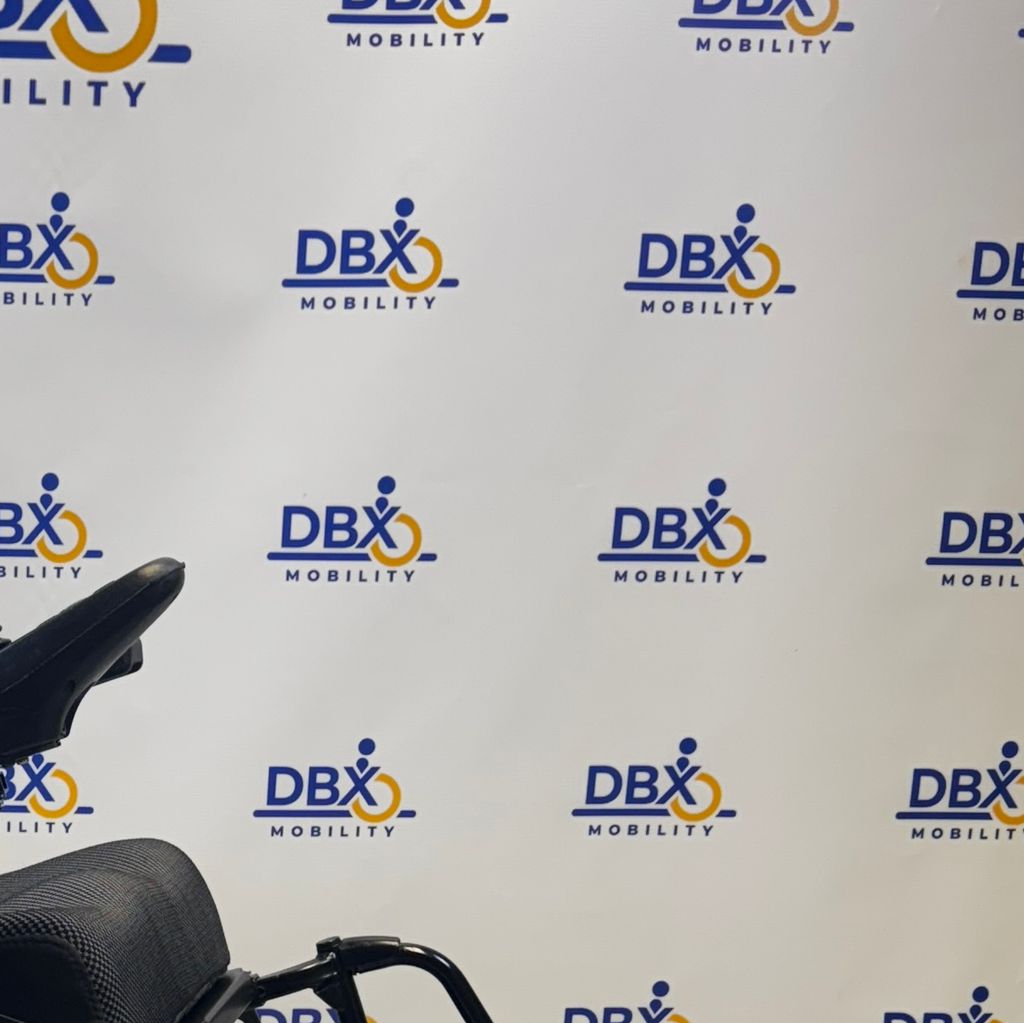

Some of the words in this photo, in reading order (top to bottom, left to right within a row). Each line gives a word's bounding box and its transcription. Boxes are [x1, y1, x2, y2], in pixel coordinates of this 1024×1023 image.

[347, 33, 484, 47] MOBILITY
[696, 38, 830, 53] MOBILITY
[296, 229, 419, 274] DBX
[638, 234, 759, 280] DBX
[301, 297, 435, 309] MOBILITY
[641, 300, 772, 315] MOBILITY
[281, 506, 400, 548] DBX
[612, 507, 730, 550] DBX
[286, 570, 414, 582] MOBILITY
[615, 570, 742, 583] MOBILITY
[267, 767, 380, 806] DBX
[585, 765, 701, 805] DBX
[910, 769, 1022, 808] DBX
[271, 826, 394, 837] MOBILITY
[589, 825, 713, 836] MOBILITY
[912, 827, 1024, 839] MOBILIT
